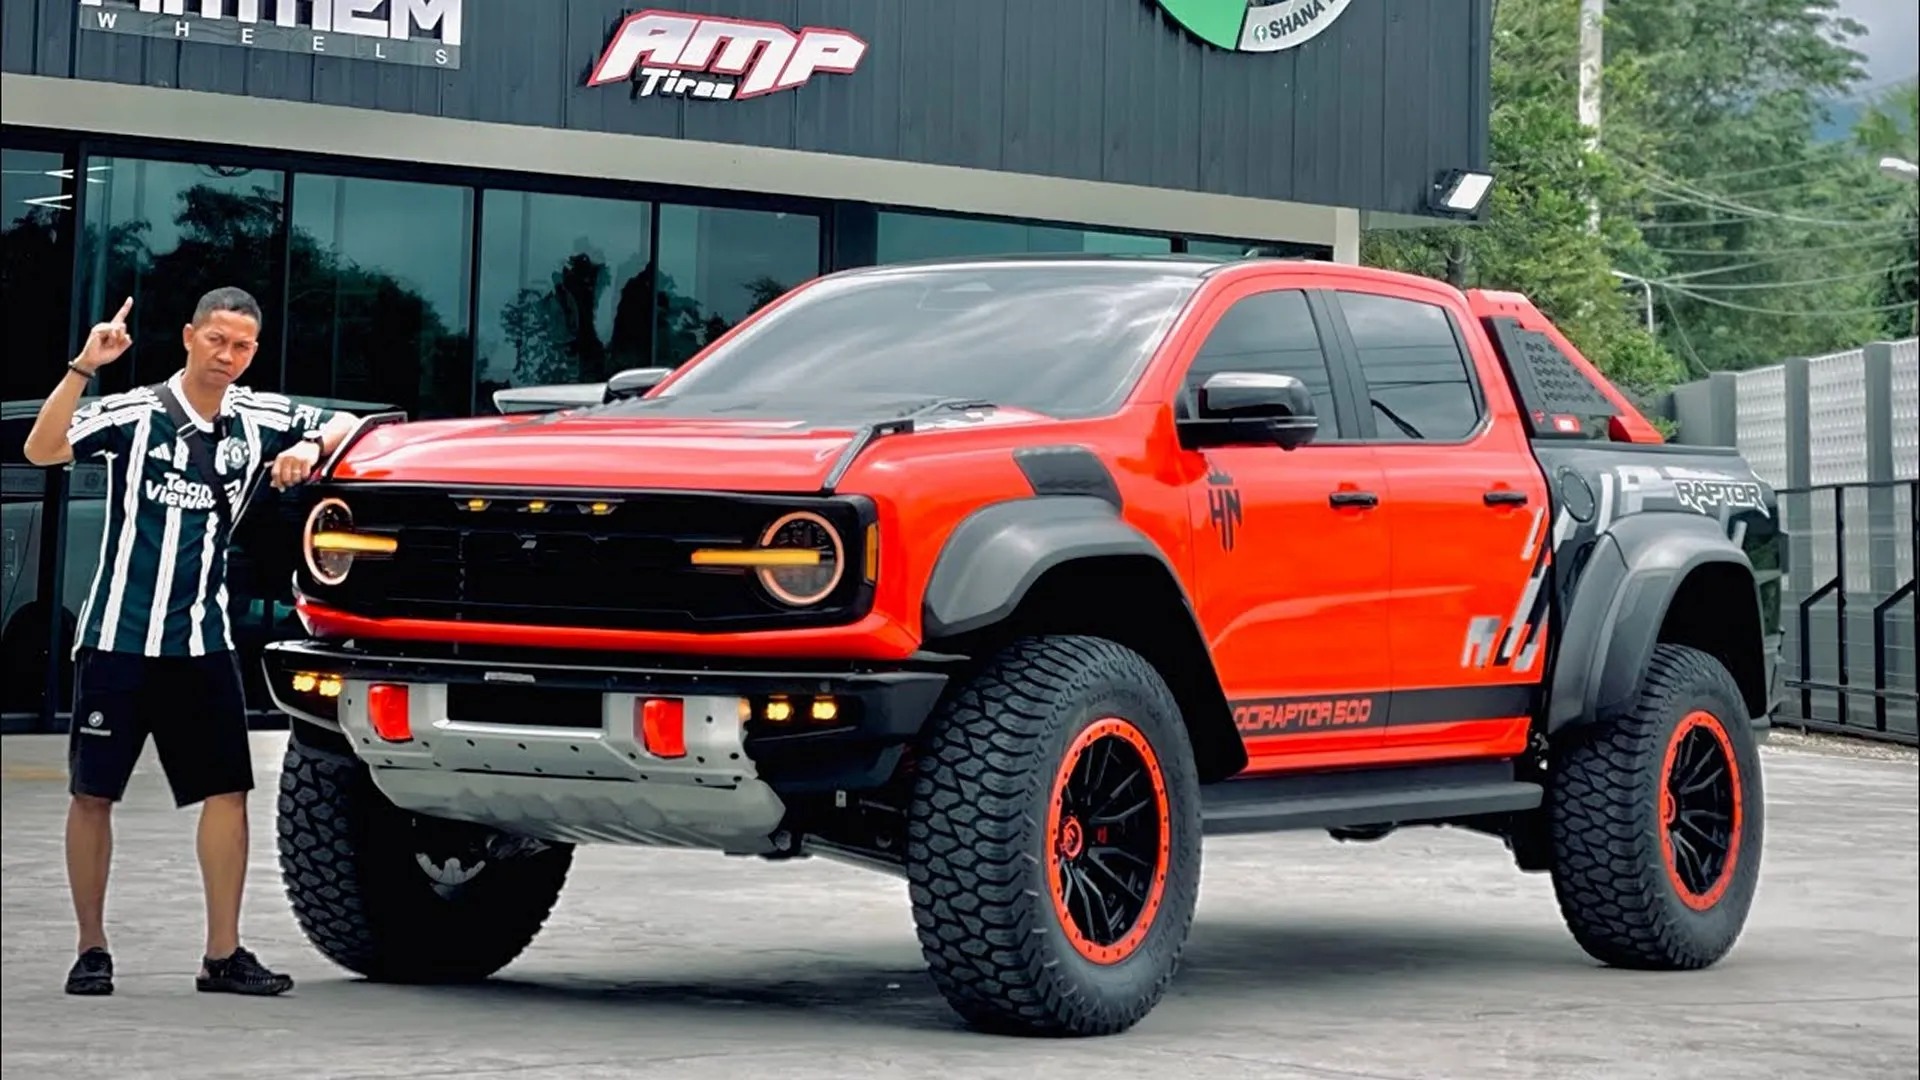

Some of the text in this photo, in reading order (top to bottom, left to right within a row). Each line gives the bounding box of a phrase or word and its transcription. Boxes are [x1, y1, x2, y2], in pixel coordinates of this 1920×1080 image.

[97, 12, 448, 65] WHEELS
[1269, 0, 1326, 39] SHANA
[587, 9, 868, 100] AMP
[640, 68, 735, 99] Tires
[1673, 480, 1770, 519] RAPTOR
[1332, 698, 1372, 725] 500
